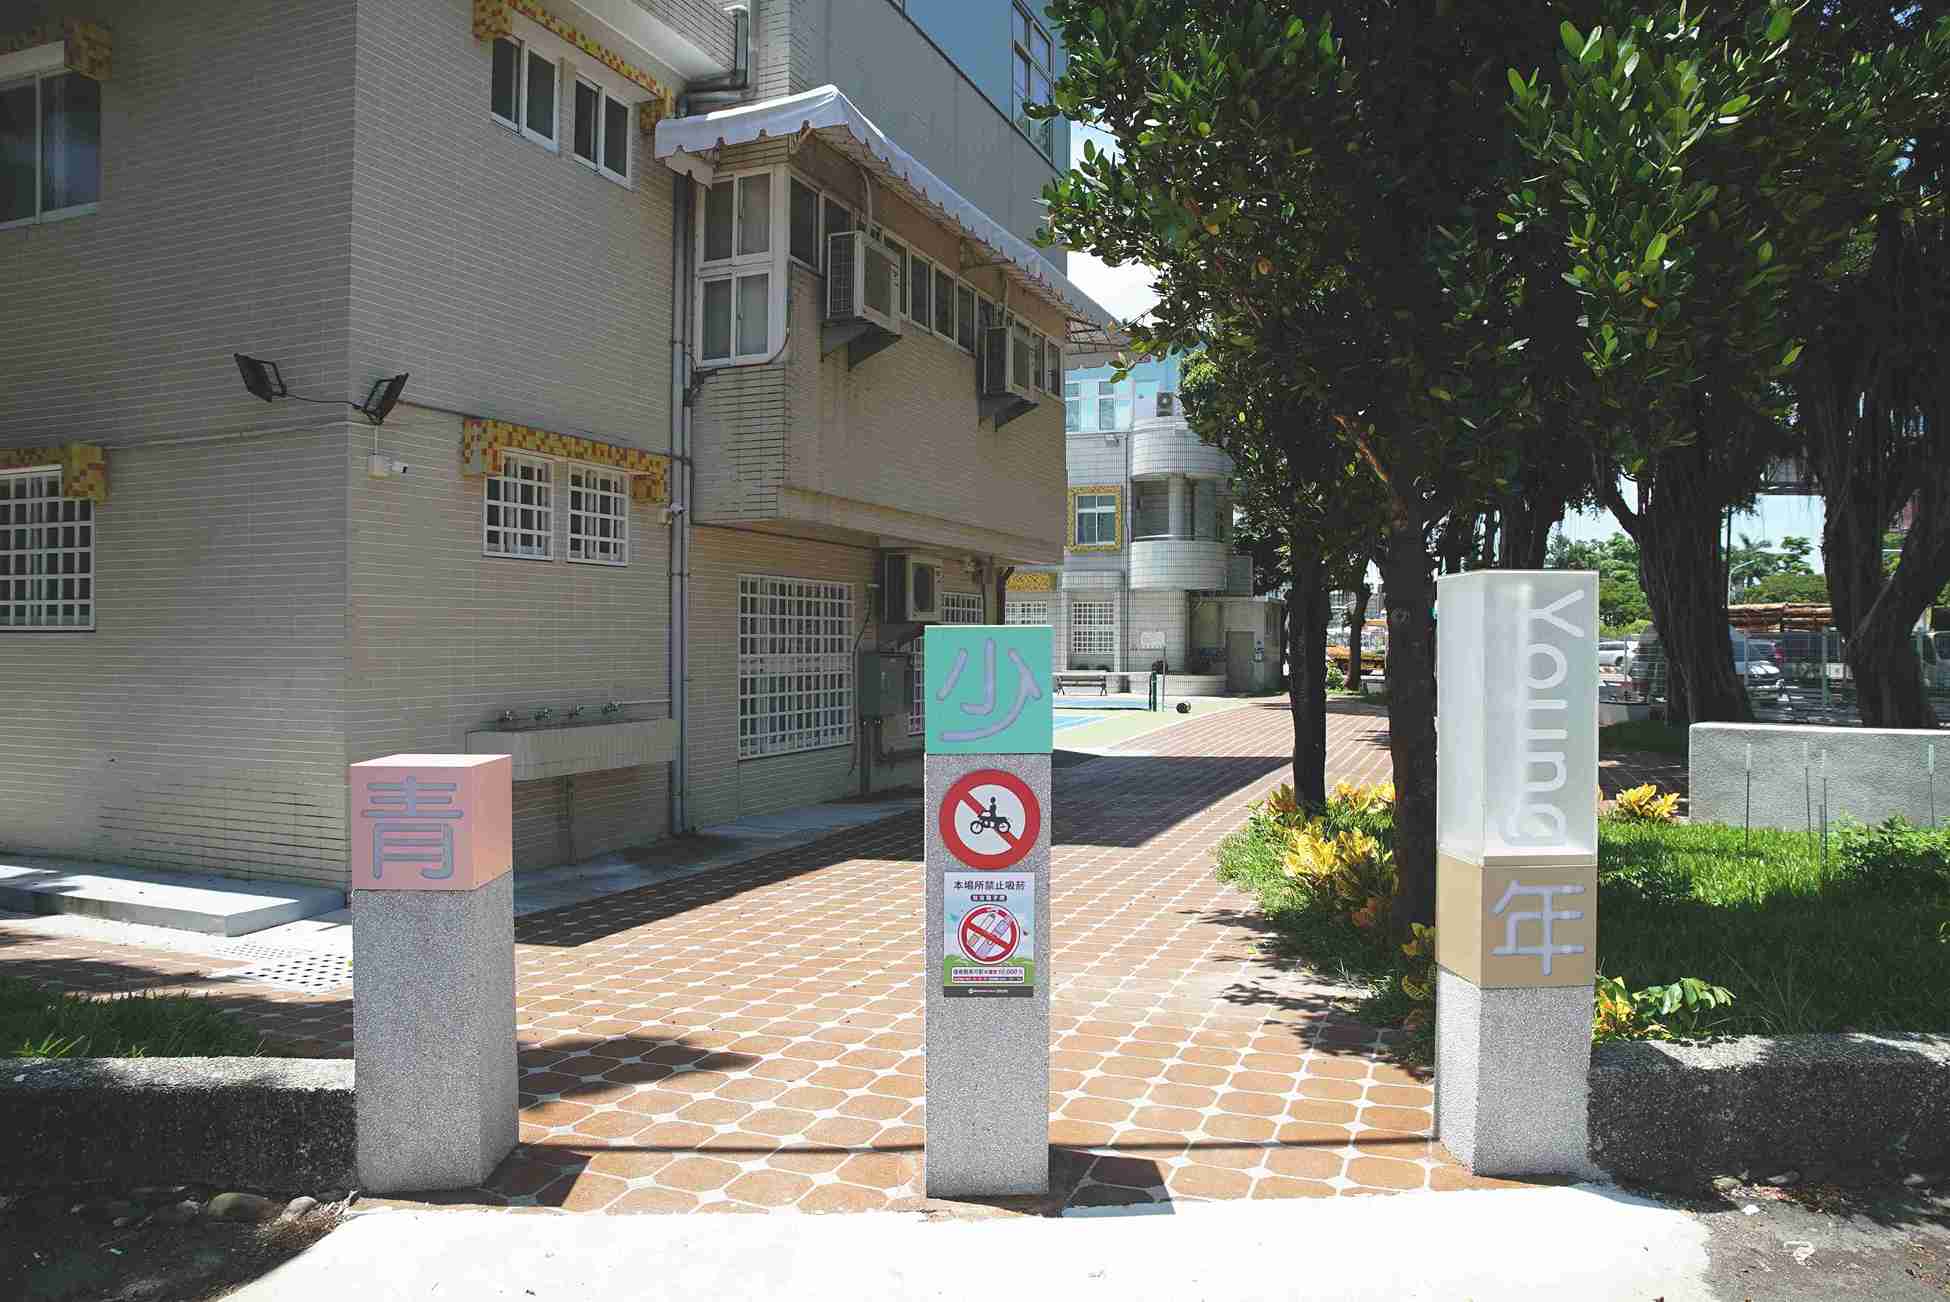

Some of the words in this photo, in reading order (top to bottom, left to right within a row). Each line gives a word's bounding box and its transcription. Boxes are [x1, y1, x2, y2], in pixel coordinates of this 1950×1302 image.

[936, 638, 1042, 741] 少
[1502, 588, 1585, 848] Young
[360, 775, 464, 880] 青
[1490, 879, 1586, 976] 年
